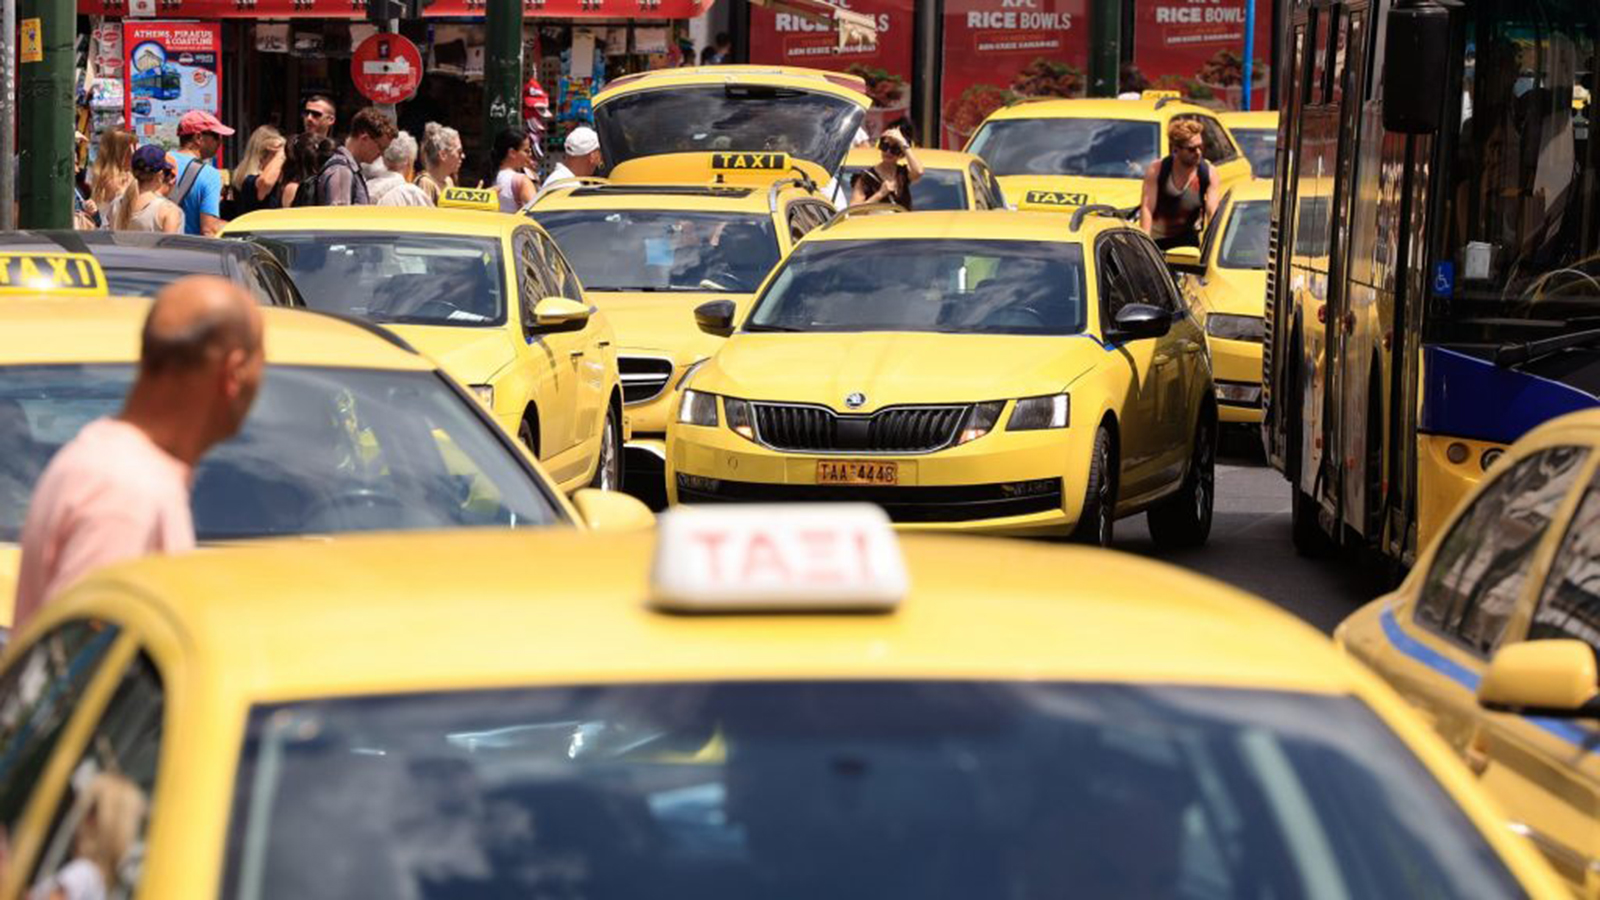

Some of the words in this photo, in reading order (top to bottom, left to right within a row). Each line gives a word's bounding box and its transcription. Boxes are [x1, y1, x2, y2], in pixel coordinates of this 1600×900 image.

[967, 11, 1016, 28] RICE
[1020, 12, 1071, 30] BOWLS
[1156, 7, 1201, 22] RICE
[1205, 7, 1246, 22] BOWL
[721, 153, 775, 168] TAXI
[450, 189, 488, 202] TAXI
[1030, 191, 1085, 204] TAXI
